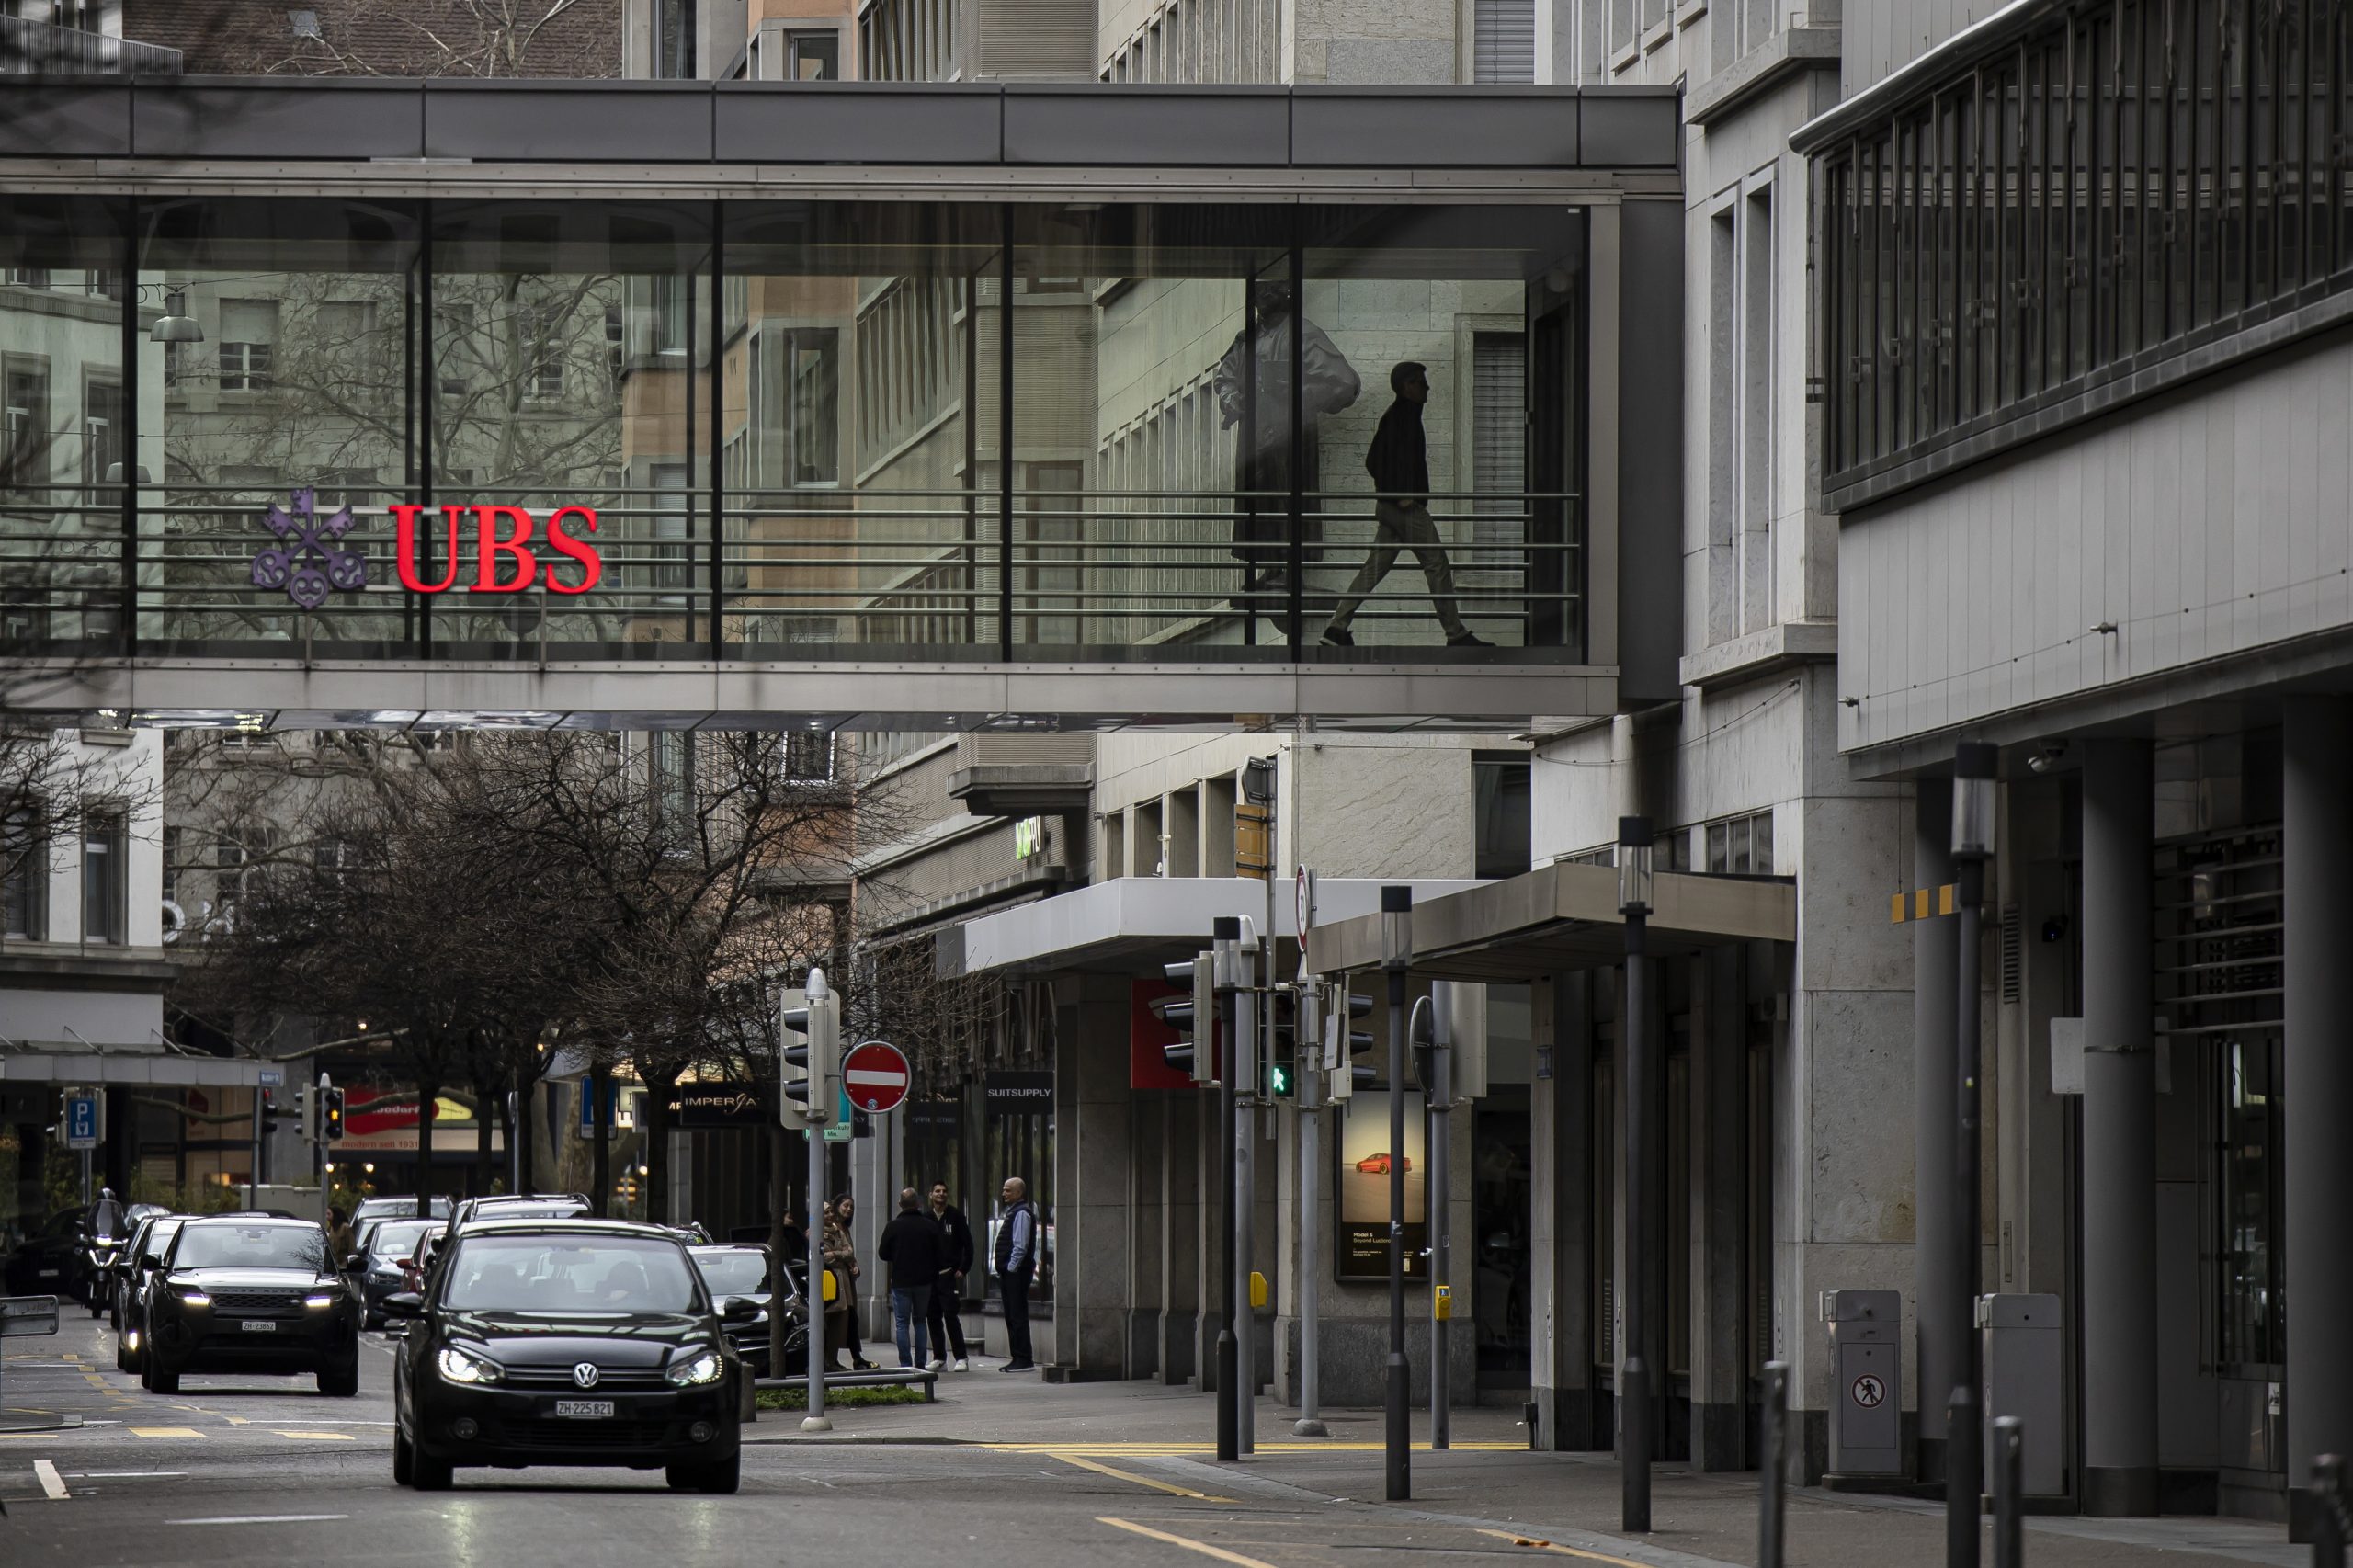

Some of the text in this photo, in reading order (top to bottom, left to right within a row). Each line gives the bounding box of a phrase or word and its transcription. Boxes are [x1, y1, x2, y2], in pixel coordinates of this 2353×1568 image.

[389, 505, 602, 594] UBS
[987, 1088, 1051, 1097] SUITSUPPLY
[77, 1103, 88, 1121] P
[342, 1140, 419, 1148] modern seit 1931
